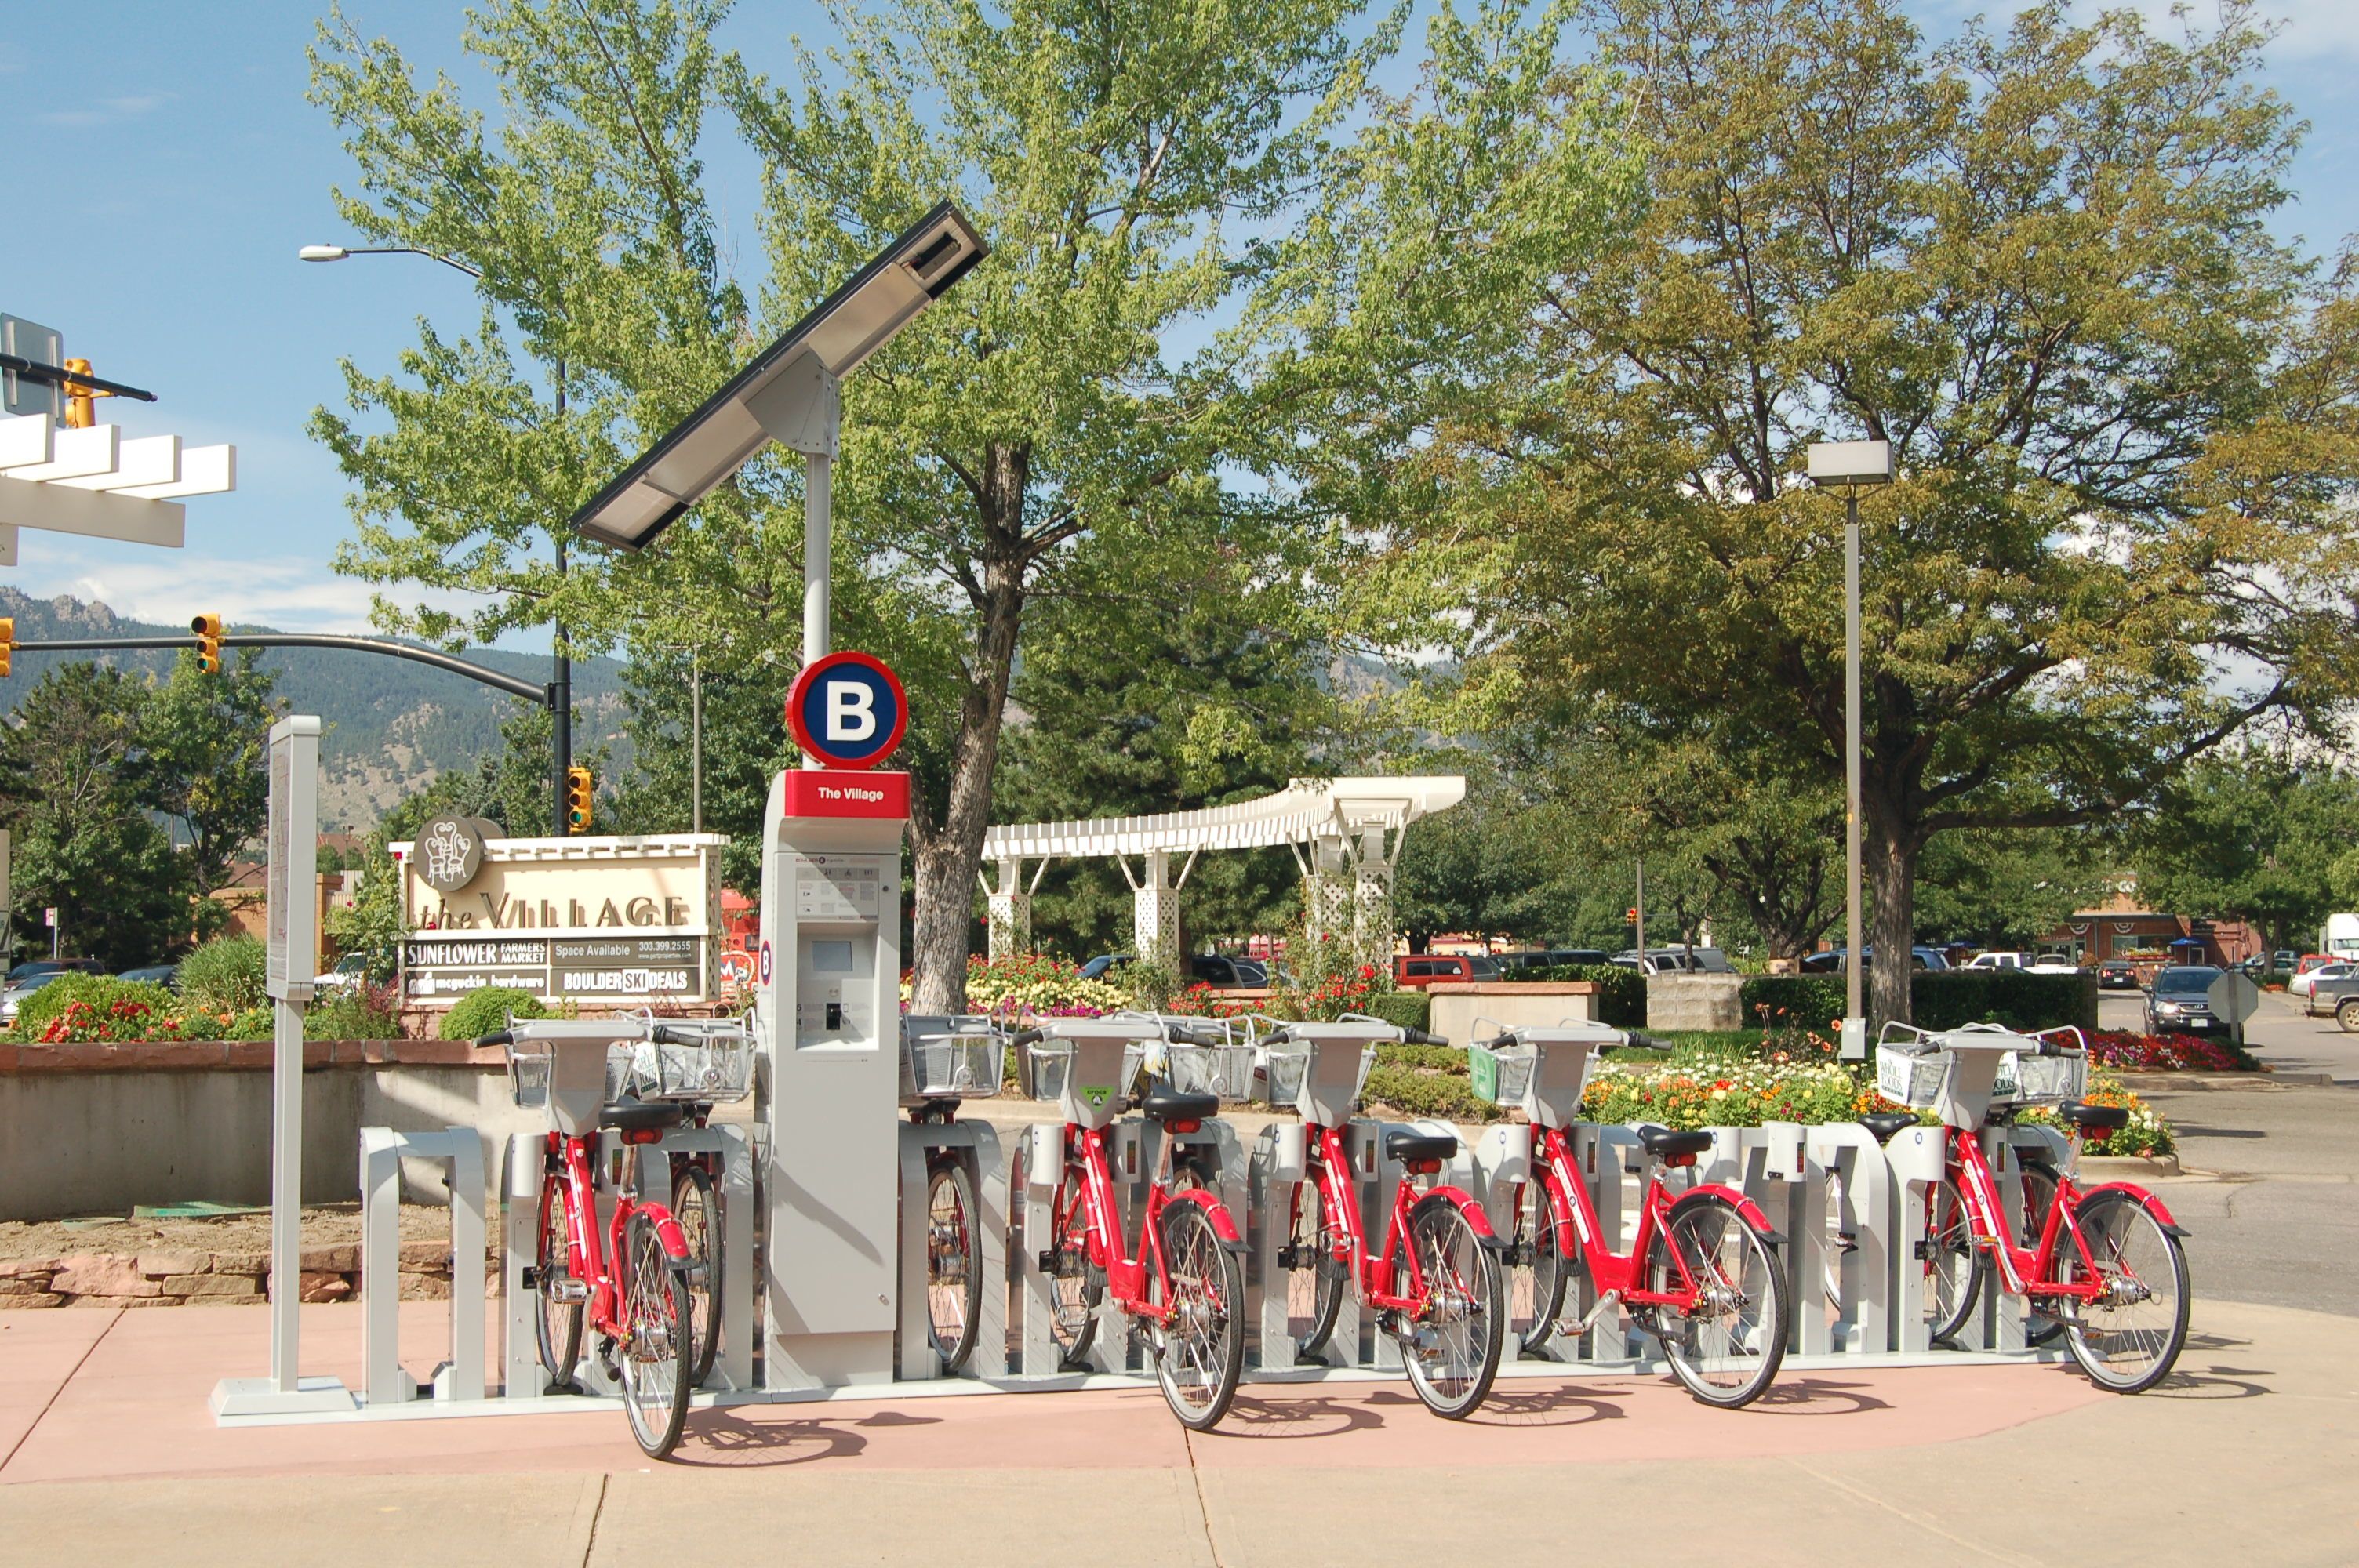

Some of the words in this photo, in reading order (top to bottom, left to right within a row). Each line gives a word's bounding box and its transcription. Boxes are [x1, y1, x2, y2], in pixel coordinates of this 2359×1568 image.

[827, 681, 876, 741] B
[818, 787, 841, 800] The
[842, 787, 884, 802] Village
[420, 898, 472, 930] the
[479, 892, 685, 929] VILLAGE
[408, 943, 497, 965] SUNFLOWER
[500, 942, 546, 953] FARMERS
[555, 945, 584, 958] Space
[587, 944, 631, 956] Available
[638, 941, 691, 952] 303.399.2555
[500, 953, 546, 964] MARKET
[491, 974, 544, 988] hardware
[564, 972, 622, 990] BOULDER
[625, 972, 646, 989] SKI
[649, 971, 688, 989] DEALS
[1880, 1061, 1902, 1079] WHOLE
[1881, 1073, 1903, 1091] FOODS
